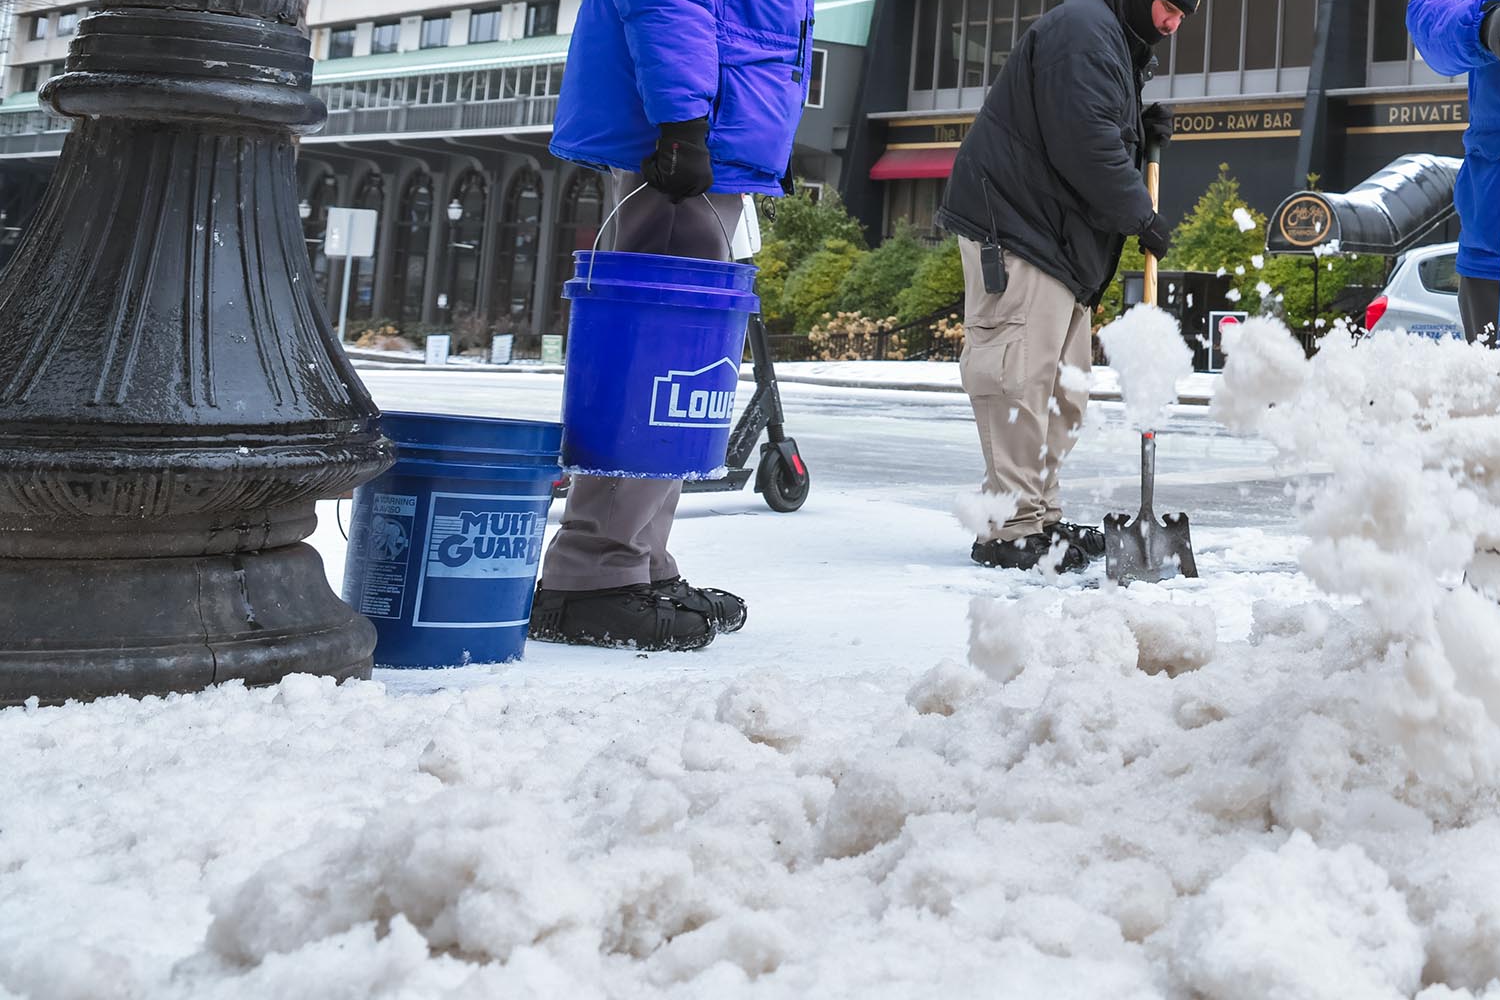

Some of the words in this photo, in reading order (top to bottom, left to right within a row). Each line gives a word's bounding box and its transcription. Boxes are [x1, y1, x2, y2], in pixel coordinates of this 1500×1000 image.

[1227, 113, 1260, 129] RAW
[1263, 112, 1292, 128] BAR
[1389, 104, 1463, 123] PRIVATE
[459, 511, 538, 536] MULTI
[438, 534, 541, 568] GUARD
